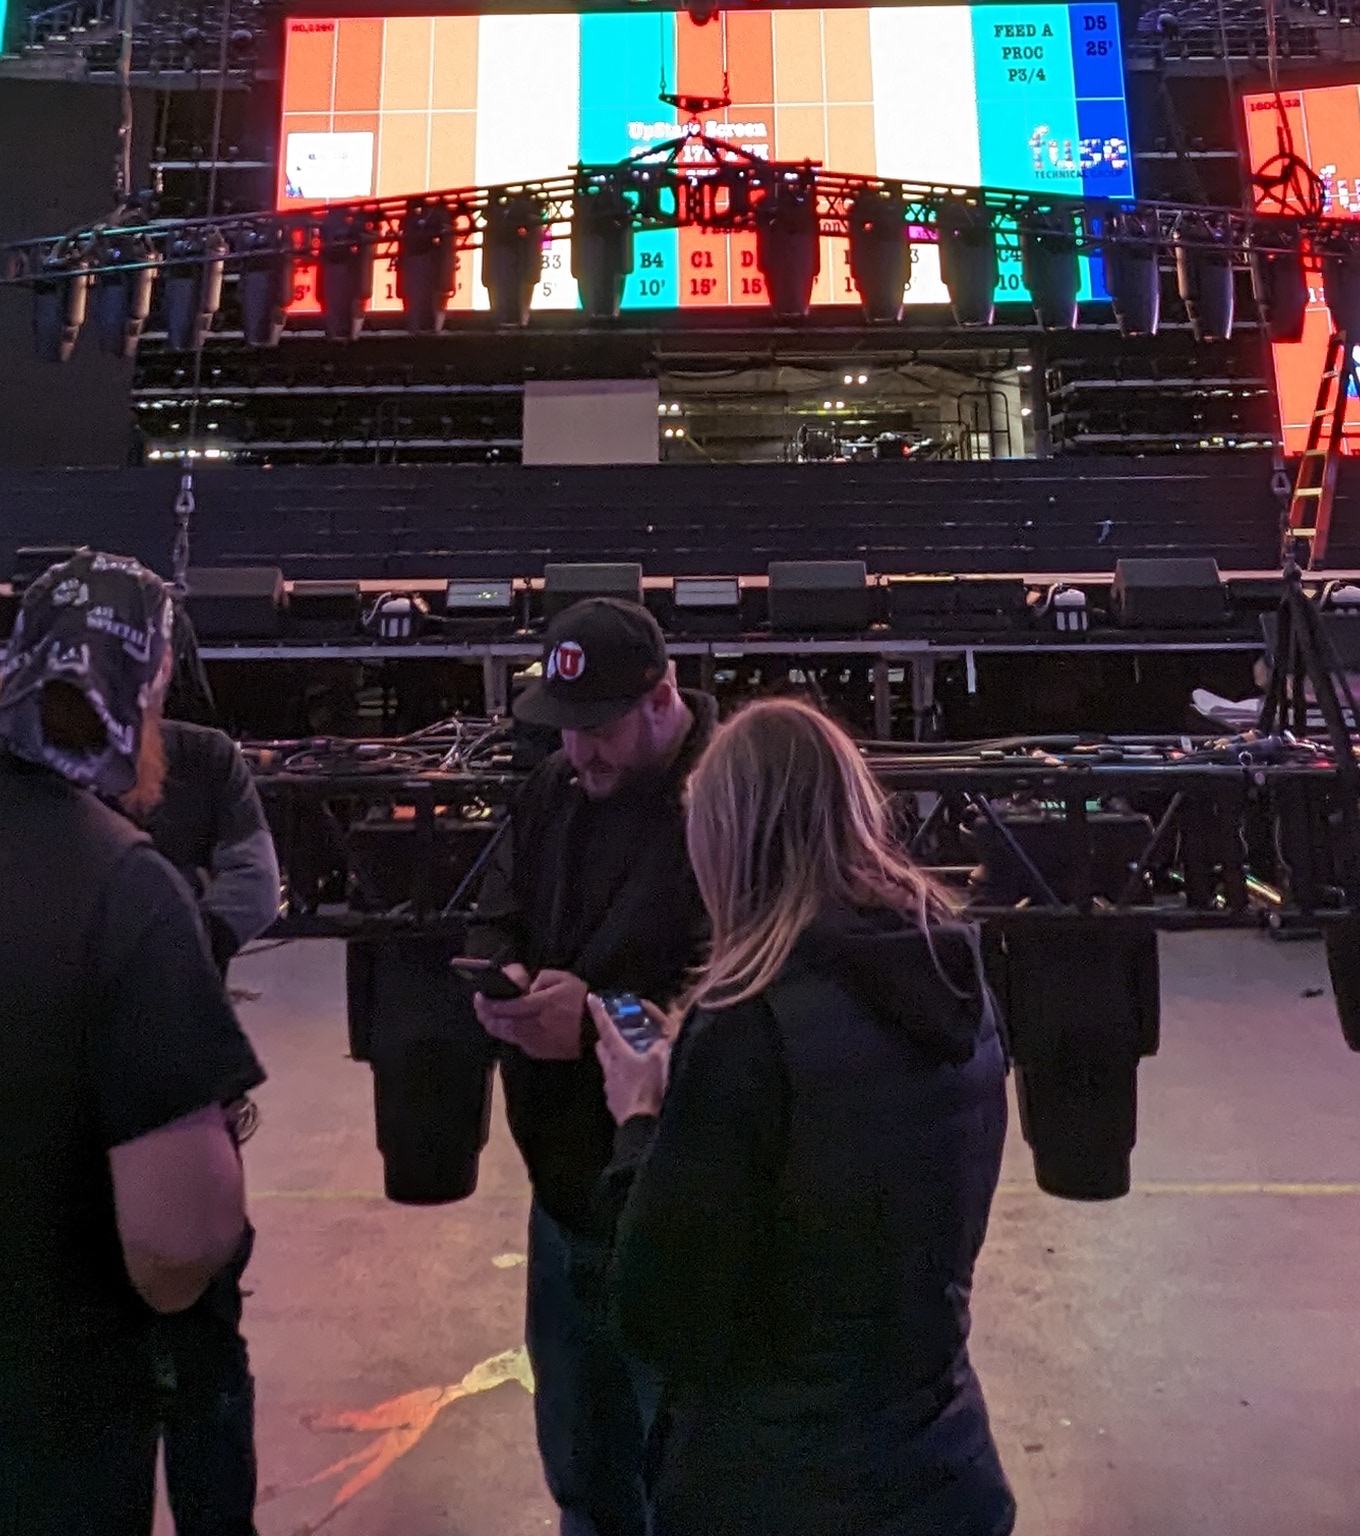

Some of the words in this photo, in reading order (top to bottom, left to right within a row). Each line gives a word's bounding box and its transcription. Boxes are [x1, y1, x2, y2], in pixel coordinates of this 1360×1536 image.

[994, 24, 1036, 38] FEED
[1042, 24, 1053, 37] A
[1083, 15, 1107, 31] D5
[1002, 46, 1043, 60] PROC
[1085, 41, 1113, 56] 25'
[1008, 68, 1046, 84] P3/4
[705, 121, 767, 137] Screen
[1035, 170, 1087, 179] TECHNICAL
[640, 253, 664, 268] B4
[691, 251, 713, 268] C1
[640, 279, 665, 296] 10'
[690, 278, 717, 295] 15'
